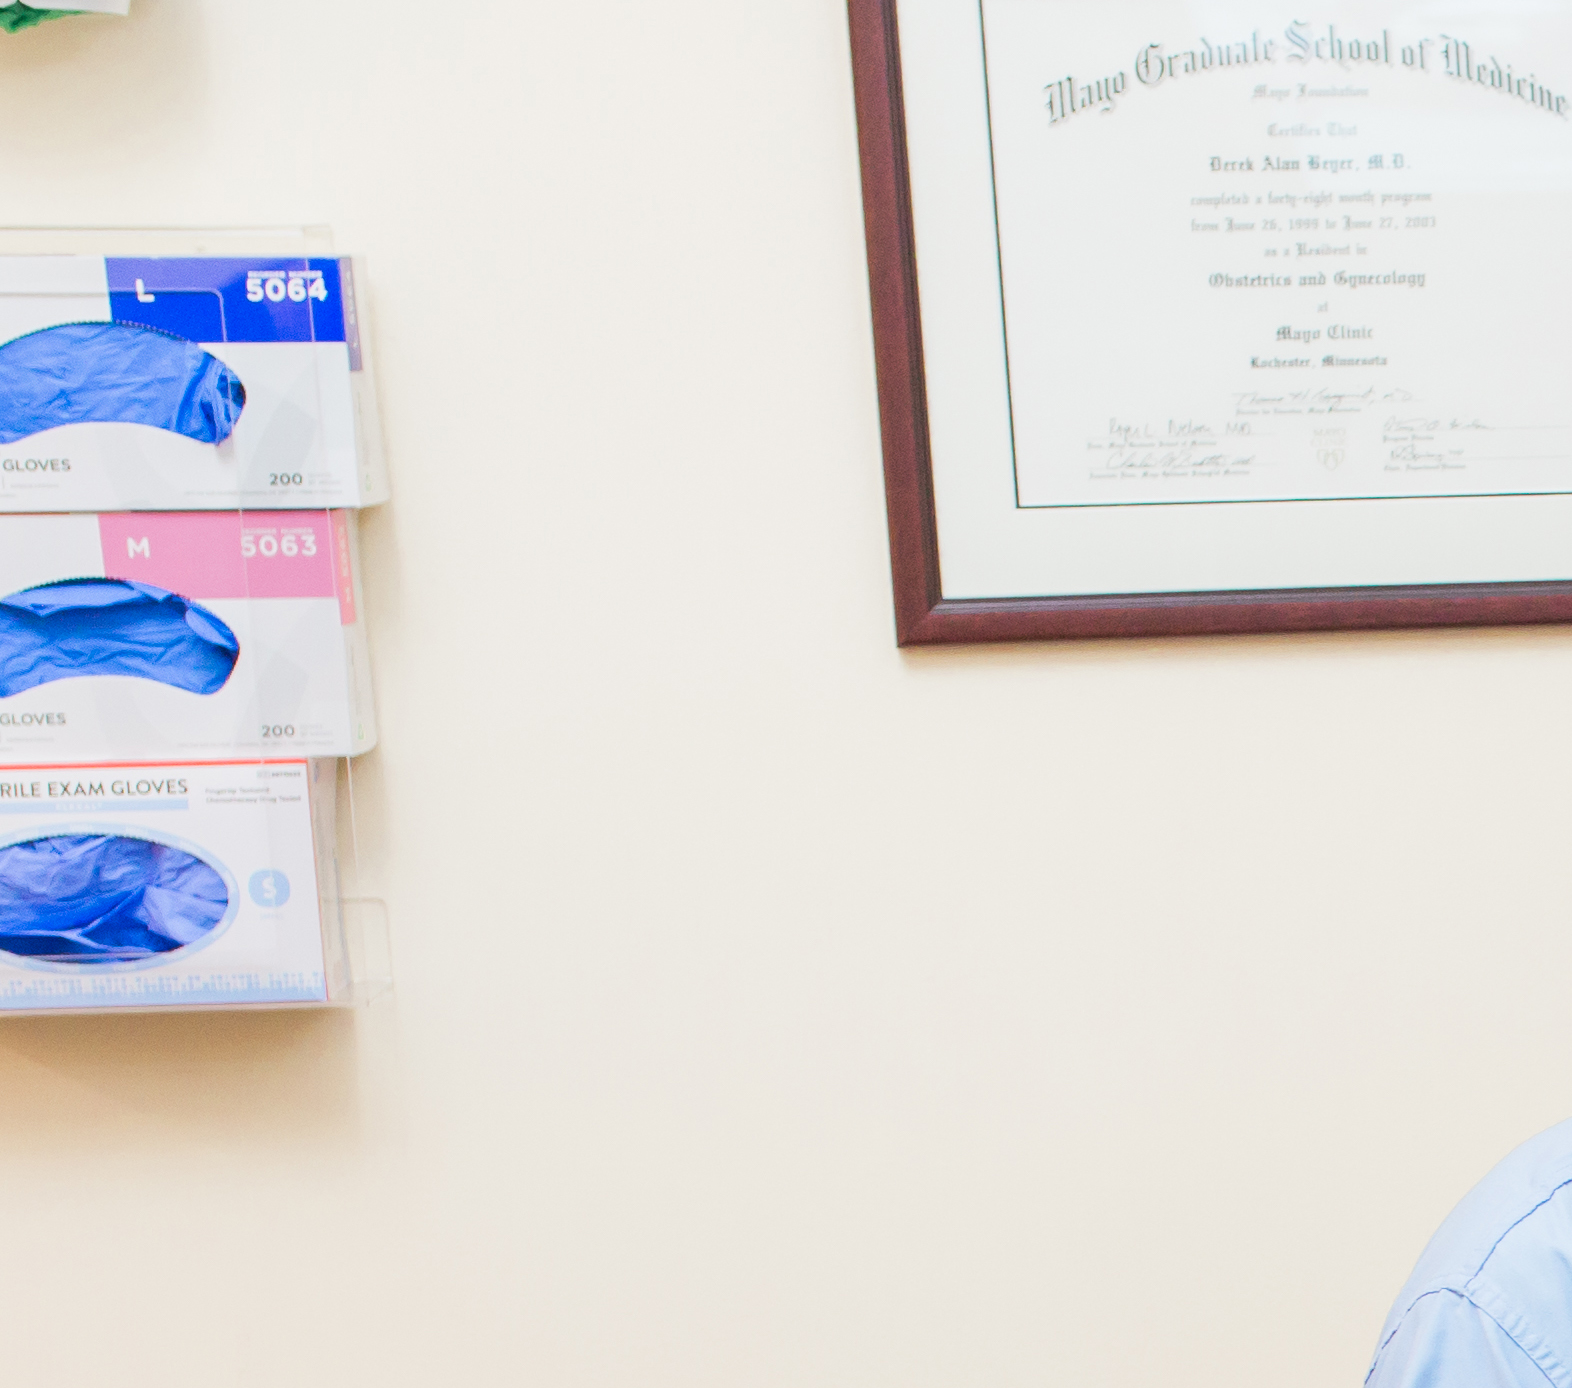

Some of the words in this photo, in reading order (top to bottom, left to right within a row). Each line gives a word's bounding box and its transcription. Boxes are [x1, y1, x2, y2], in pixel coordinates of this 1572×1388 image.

[1042, 70, 1127, 126] Mayo
[1134, 29, 1275, 86] Graduate
[1284, 18, 1393, 70] School
[1400, 36, 1433, 71] of
[1440, 33, 1572, 121] Medicine
[1209, 155, 1254, 172] Derek
[1261, 155, 1300, 172] Alan
[1367, 153, 1412, 171] M.D.
[1208, 272, 1292, 288] Obstetrics
[1298, 271, 1326, 286] and
[1333, 270, 1426, 289] Gynecology
[136, 278, 155, 303] L
[246, 277, 328, 302] 5064
[1275, 325, 1321, 343] Mayo
[1327, 324, 1374, 340] Clinic
[2, 458, 72, 472] GLOVES
[269, 473, 303, 486] 200
[126, 537, 151, 559] M
[241, 535, 317, 558] 5063
[0, 711, 67, 726] GLOVES
[261, 724, 295, 738] 200
[48, 780, 105, 797] EXAM
[111, 779, 189, 795] GLOVES
